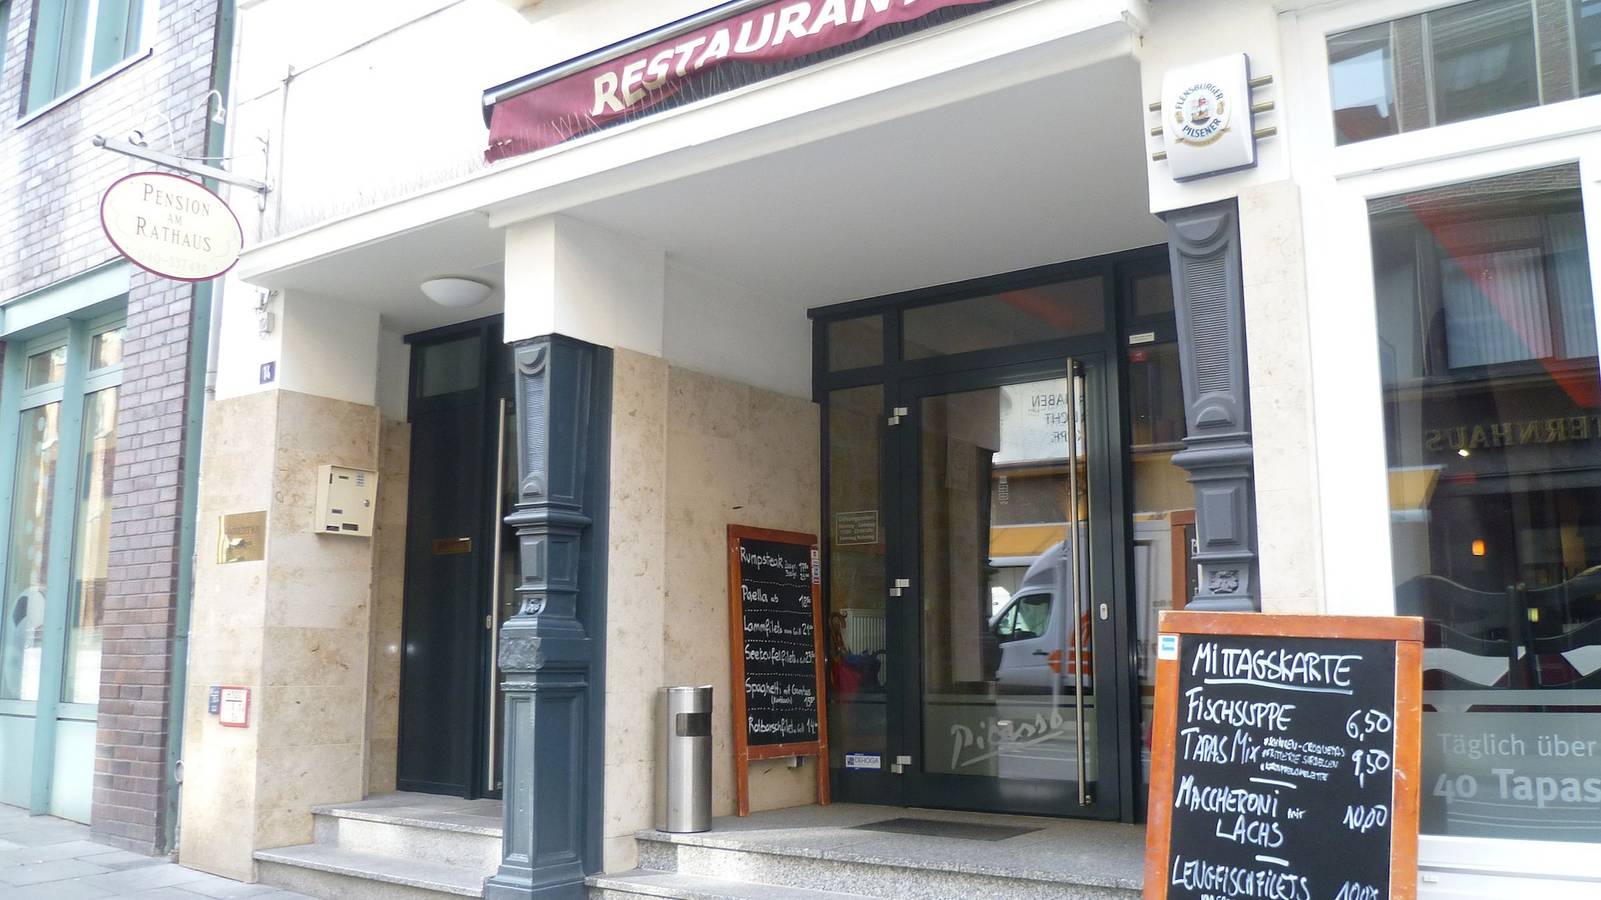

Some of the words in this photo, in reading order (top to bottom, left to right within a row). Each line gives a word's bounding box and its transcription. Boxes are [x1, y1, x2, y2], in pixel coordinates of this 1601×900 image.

[591, 0, 917, 117] RESTAURAN
[1175, 82, 1224, 109] FLENSBURGER
[1182, 118, 1221, 138] PILSENER
[143, 183, 210, 216] PENSION
[136, 216, 212, 253] RATHAUS
[167, 213, 183, 226] AM
[741, 584, 768, 603] Paella
[1192, 641, 1363, 687] MITTAGSKARTE
[1185, 686, 1296, 731] FISCHSUPPE
[1346, 709, 1391, 741] 6,50
[1180, 727, 1228, 764] TAPAS
[1351, 749, 1390, 788] 9,50
[1437, 733, 1526, 760] Täglich
[1537, 734, 1597, 757] über
[1174, 774, 1280, 818] MACCHERONI
[1342, 805, 1387, 833] 10,00
[1432, 773, 1478, 804] 40
[1491, 768, 1601, 809] Tapas
[1215, 814, 1284, 848] LACHS
